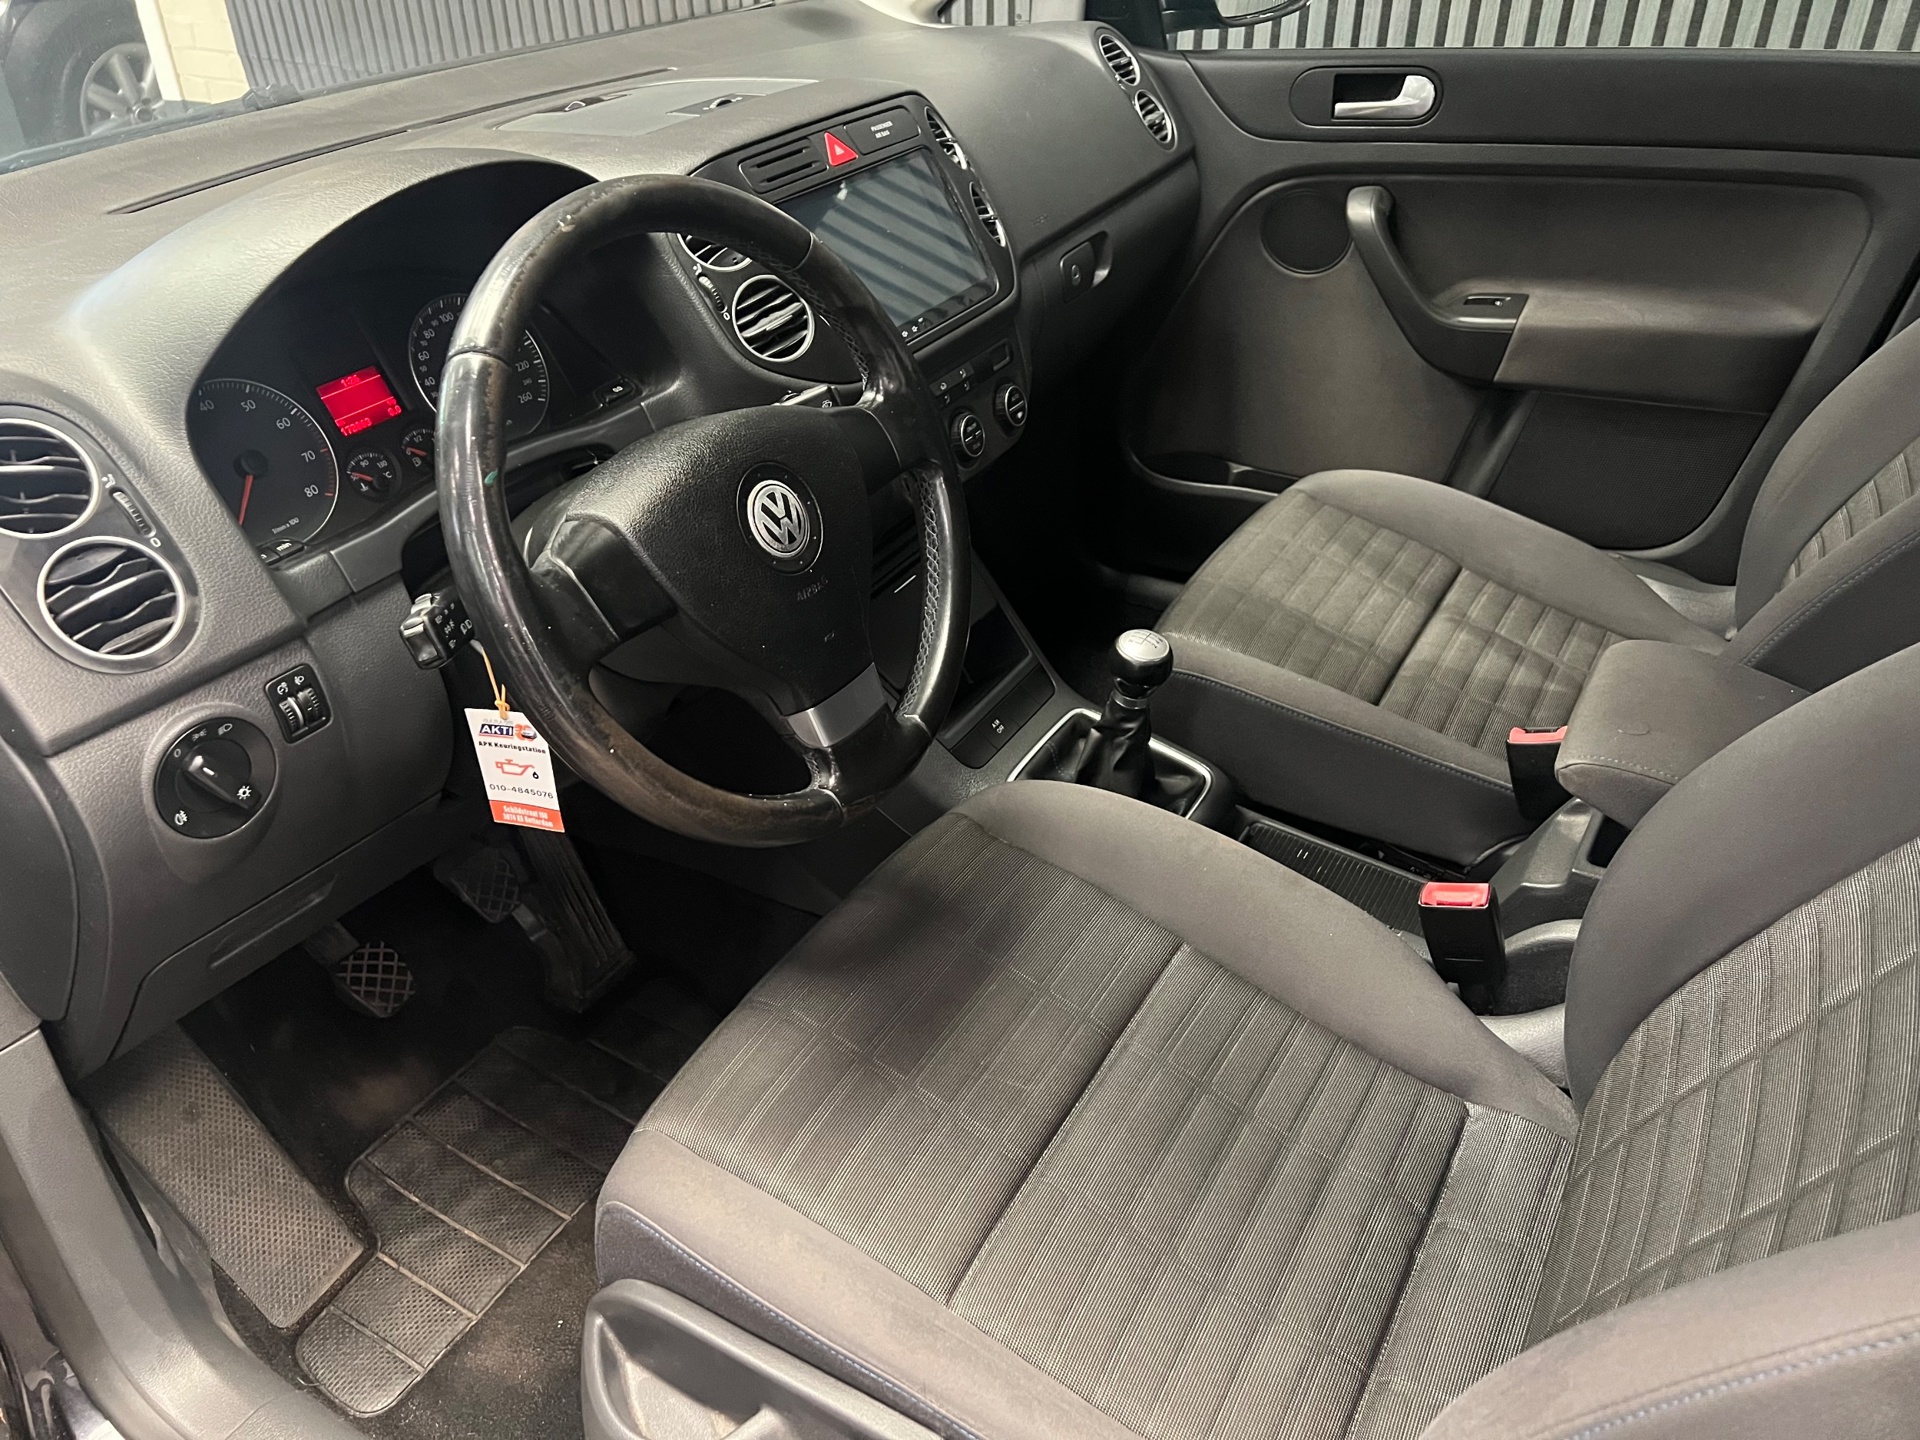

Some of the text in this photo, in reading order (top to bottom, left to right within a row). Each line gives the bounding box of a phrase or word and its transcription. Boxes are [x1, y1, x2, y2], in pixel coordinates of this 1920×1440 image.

[439, 311, 454, 323] 100
[423, 328, 435, 339] 80
[418, 350, 430, 361] 60
[515, 359, 530, 372] 220
[424, 376, 436, 387] 40
[517, 391, 533, 404] 260
[200, 399, 215, 412] 40
[240, 399, 256, 412] 50
[276, 417, 291, 430] 60
[301, 450, 316, 463] 70
[360, 459, 369, 468] 90
[304, 484, 319, 498] 80
[276, 542, 292, 552] min
[478, 740, 546, 754] APK Keuringstation
[489, 783, 554, 799] 010-4845076
